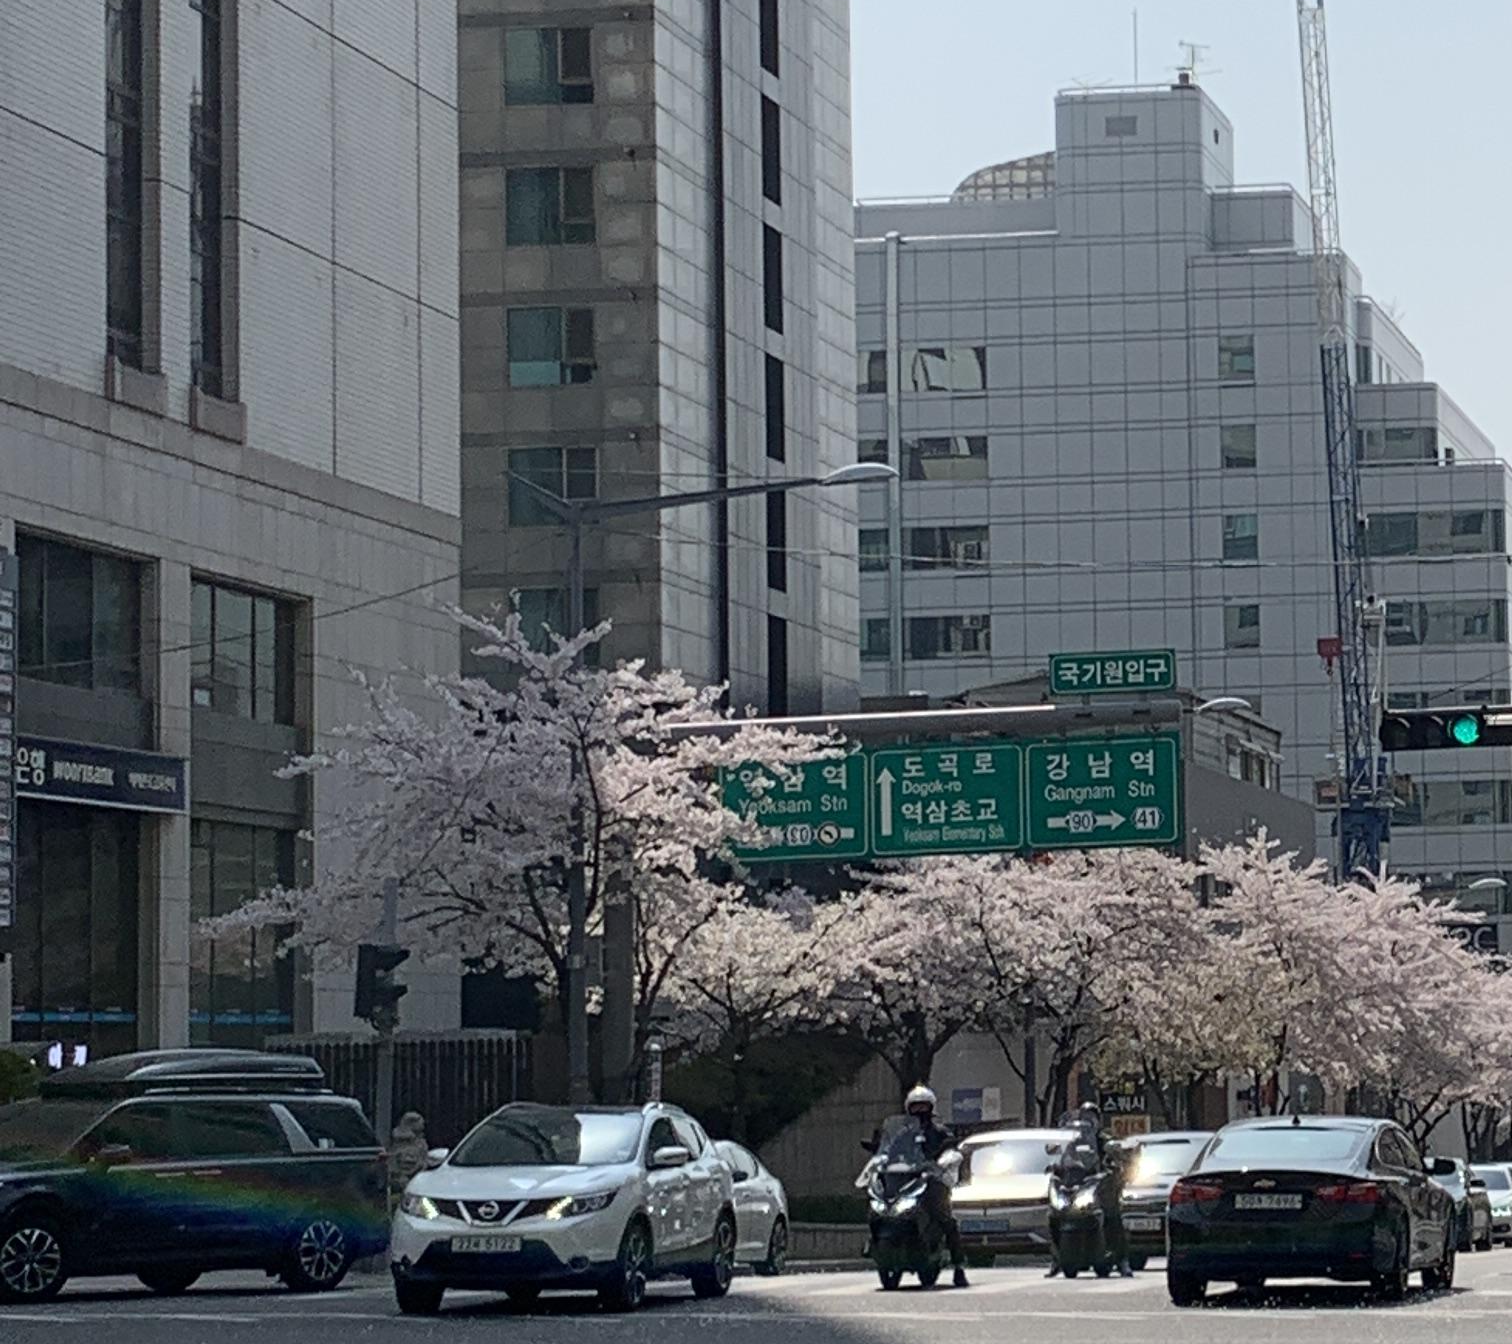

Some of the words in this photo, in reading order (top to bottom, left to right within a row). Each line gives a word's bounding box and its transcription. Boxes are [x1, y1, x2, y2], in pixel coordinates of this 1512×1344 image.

[1058, 659, 1168, 686] 국기원입구
[902, 752, 996, 778] 도곡로
[1046, 749, 1154, 781] 강남역
[902, 780, 962, 797] Dogok-ro
[1044, 783, 1116, 805] Gangnam
[1127, 779, 1156, 798] Stn
[820, 794, 848, 812] Stn
[901, 797, 999, 825] 역삼초교
[1071, 812, 1092, 831] 90
[1136, 809, 1157, 827] 41
